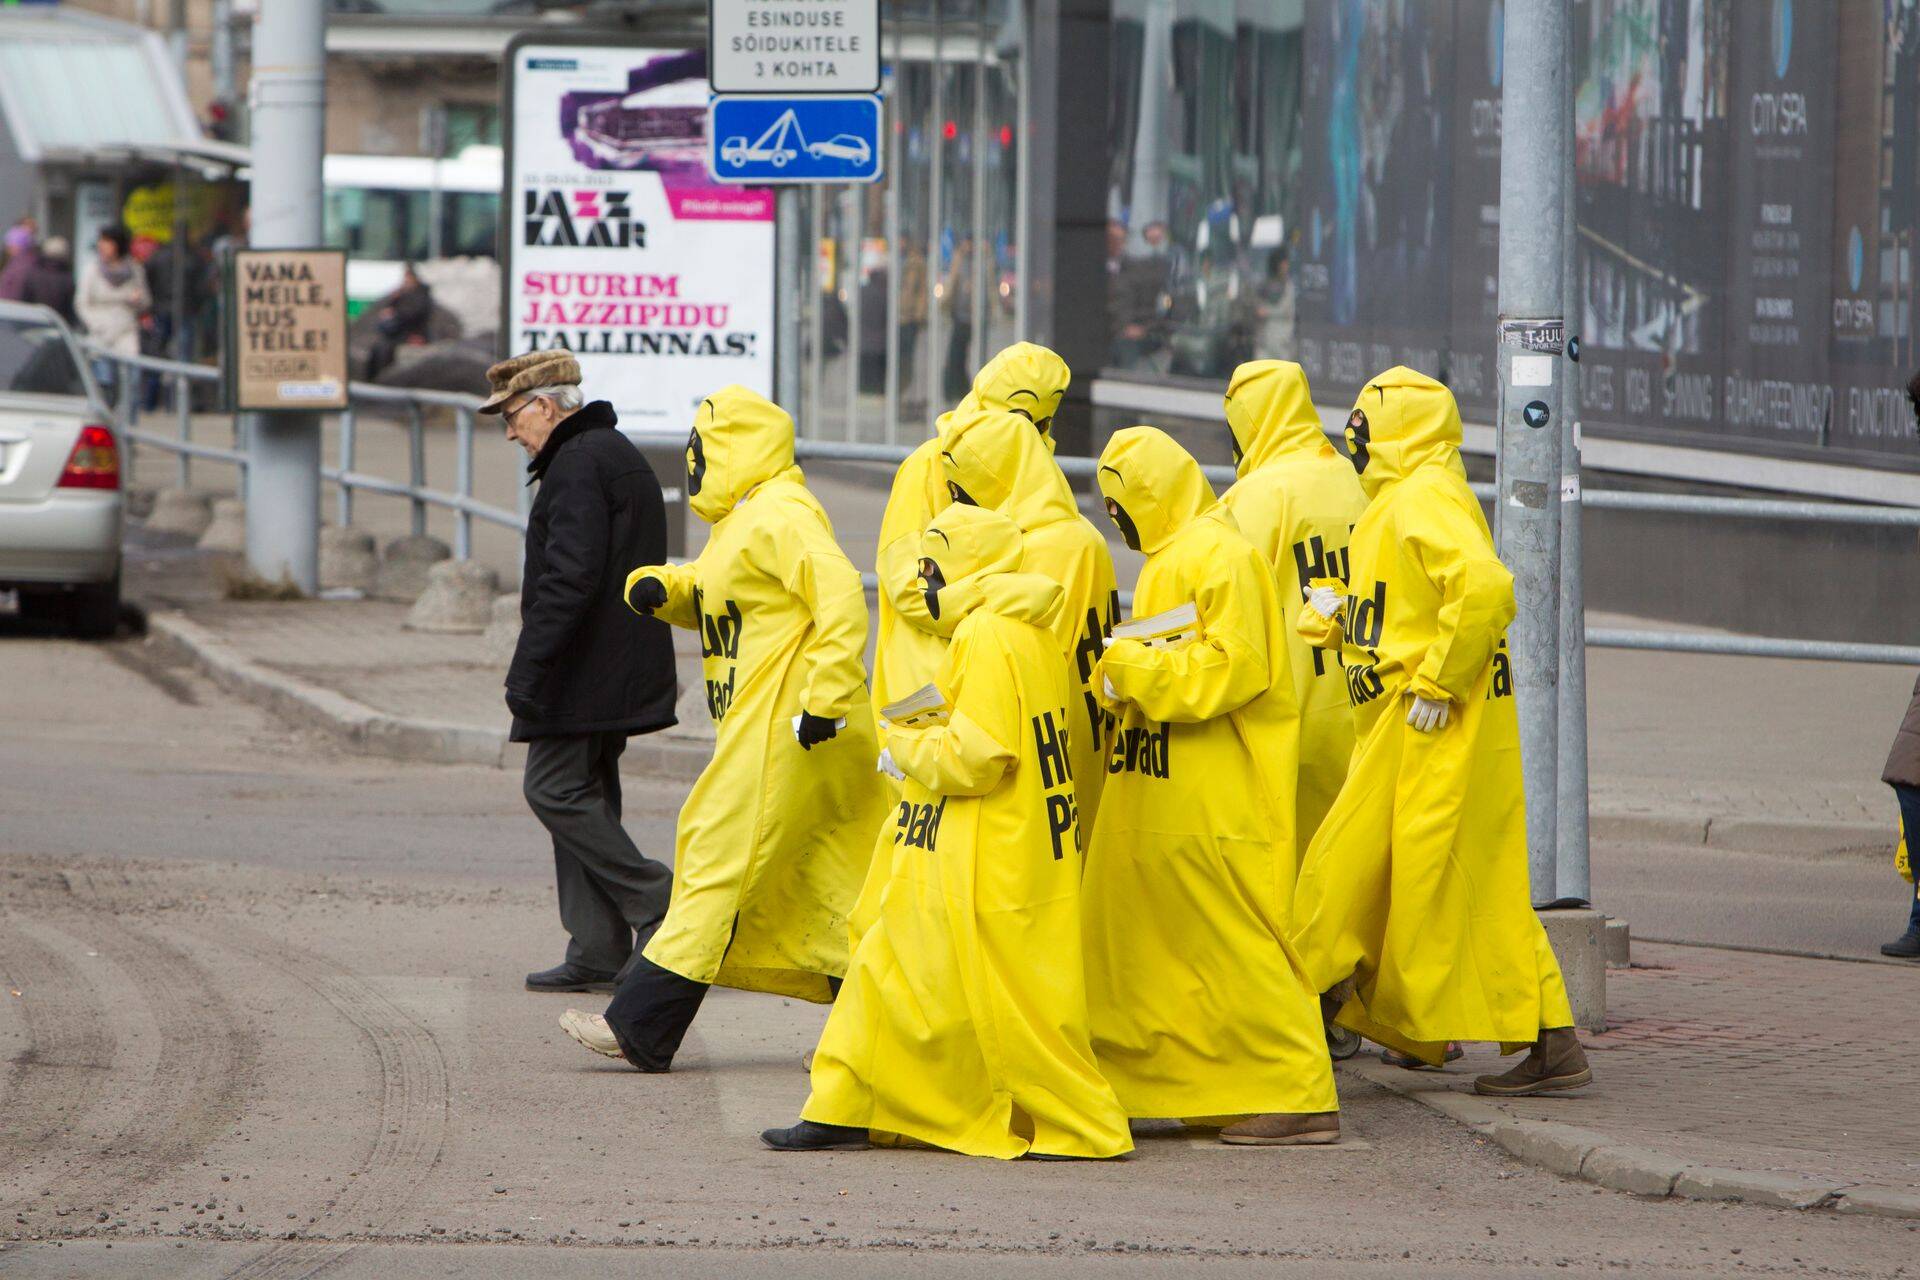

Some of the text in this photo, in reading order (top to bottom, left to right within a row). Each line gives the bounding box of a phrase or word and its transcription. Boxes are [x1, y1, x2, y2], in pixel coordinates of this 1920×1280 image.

[747, 11, 845, 26] ESINDUSE
[732, 33, 861, 51] SÕIDUKITELE
[755, 61, 838, 77] 3 KOHTA
[1780, 93, 1808, 136] SPA
[246, 261, 314, 281] VANA
[522, 272, 680, 298] SUURIM
[246, 307, 297, 328] UUS
[522, 302, 730, 328] JAZZIPIDU
[247, 330, 330, 351] TEILE!
[522, 330, 758, 357] TALLINNAS!
